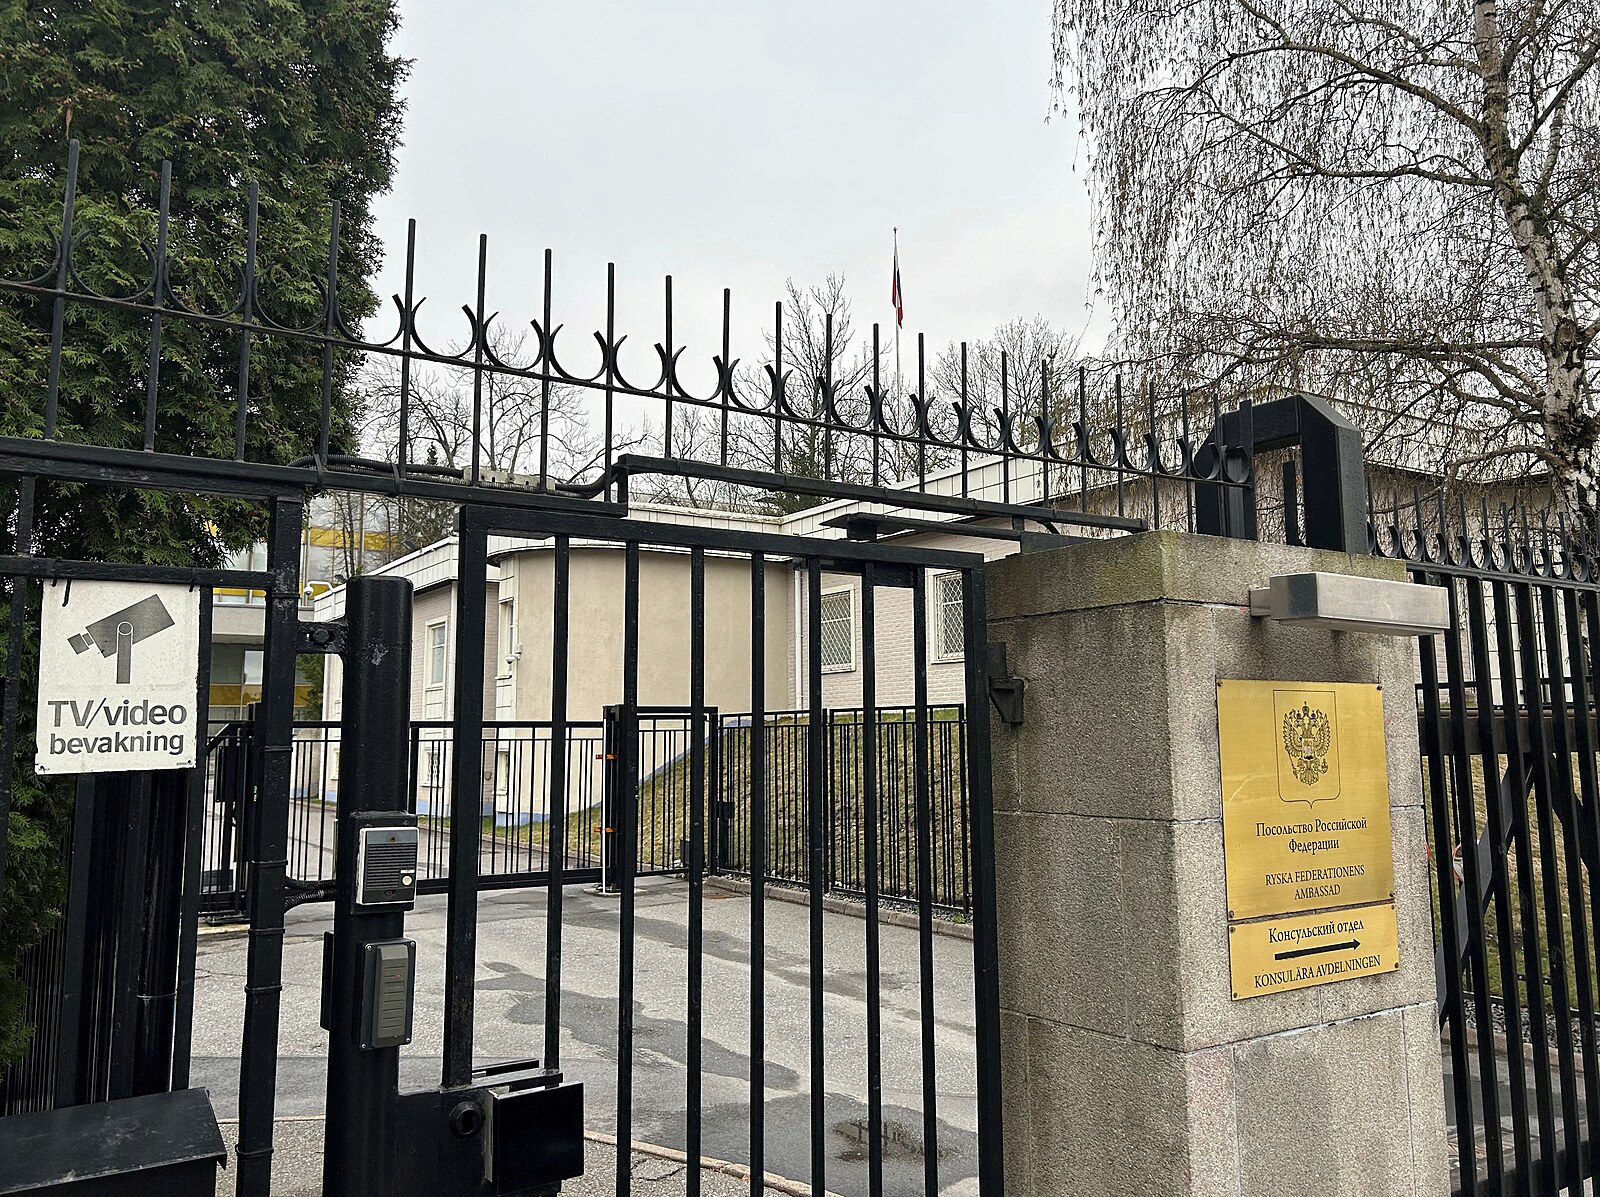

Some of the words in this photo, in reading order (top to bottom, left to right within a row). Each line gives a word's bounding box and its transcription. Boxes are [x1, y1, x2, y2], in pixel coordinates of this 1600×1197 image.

[47, 697, 188, 729] TV/video
[49, 730, 184, 755] bevakning
[1256, 822, 1313, 837] Посольство
[1315, 817, 1367, 832] Российской
[1288, 839, 1339, 855] Федерации
[1265, 872, 1293, 885] RYSKA
[1295, 864, 1365, 882] FEDERATIONENS
[1294, 884, 1341, 900] AMBASSAD
[1268, 921, 1335, 944] Консульский
[1337, 920, 1364, 933] отдел
[1254, 967, 1316, 988] KONSULÄRA
[1316, 955, 1381, 977] AVDELNINGEN
